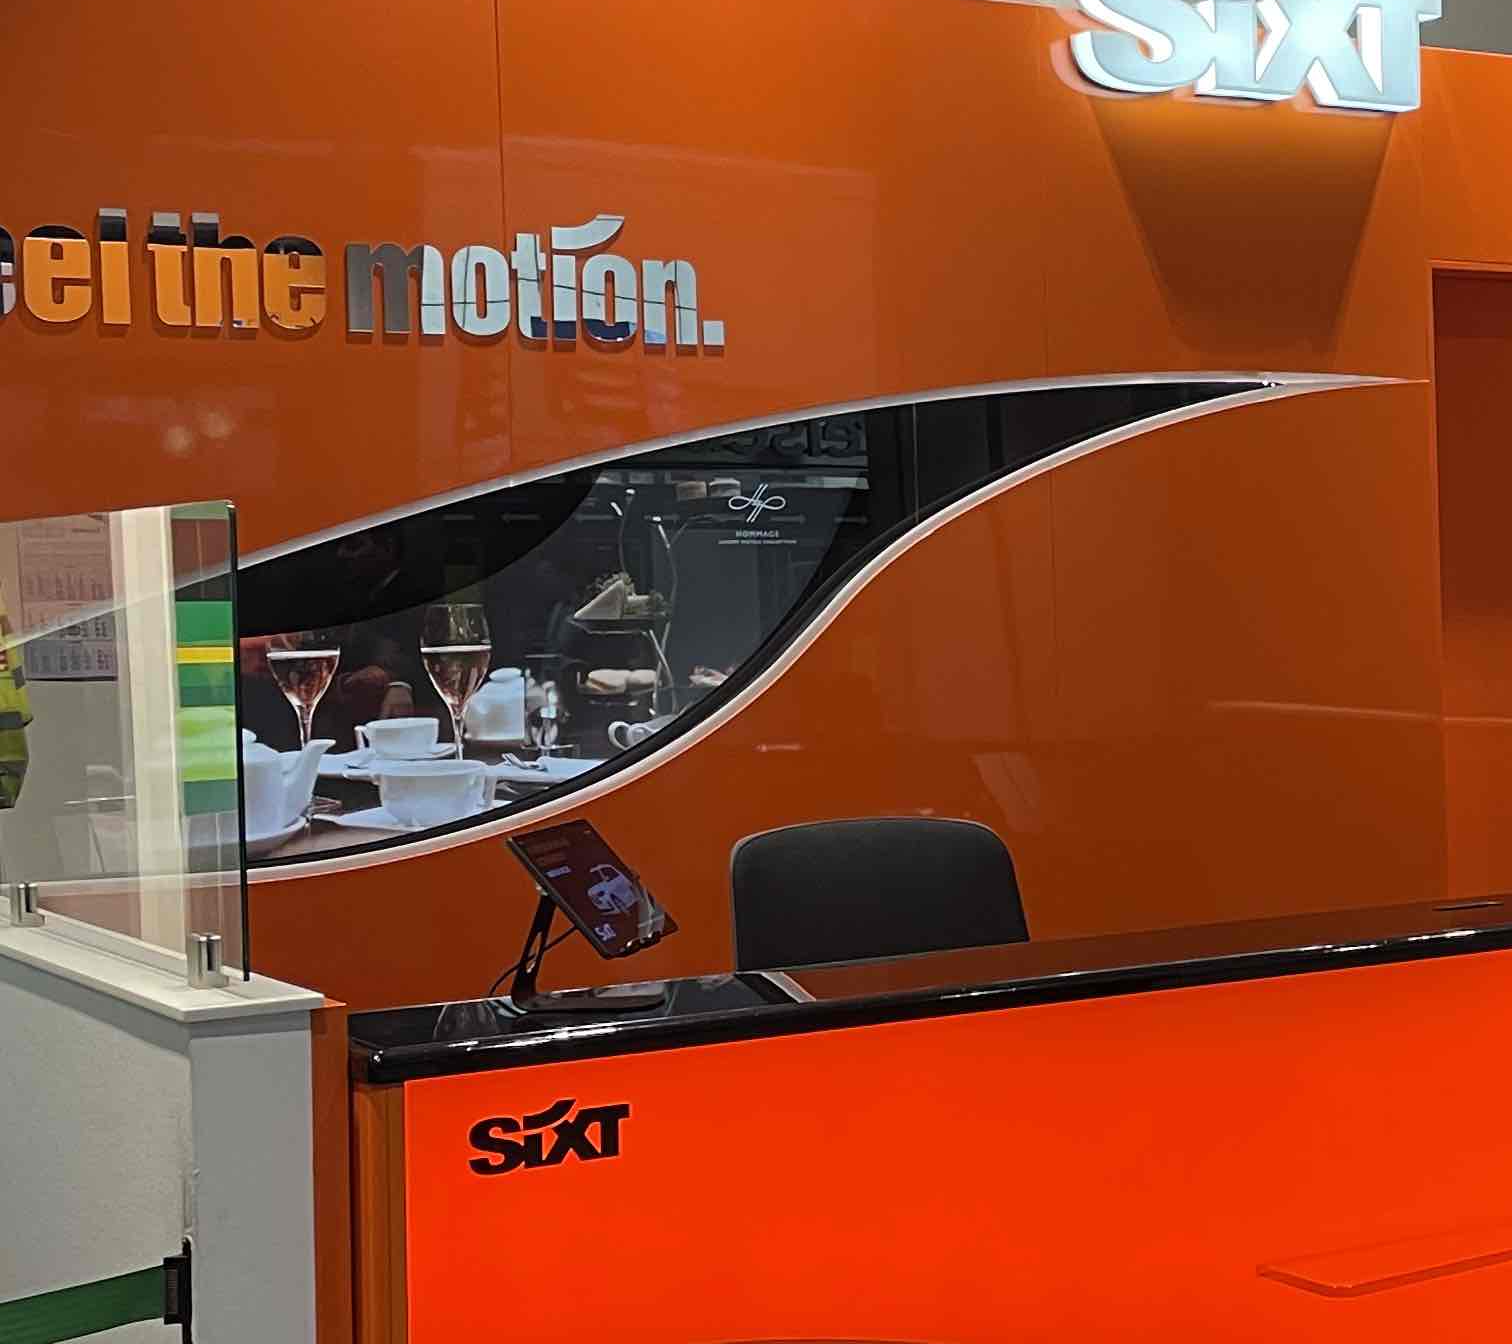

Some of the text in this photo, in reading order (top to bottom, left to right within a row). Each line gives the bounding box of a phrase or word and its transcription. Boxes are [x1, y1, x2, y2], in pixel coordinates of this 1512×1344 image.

[0, 207, 725, 347] el the motion.
